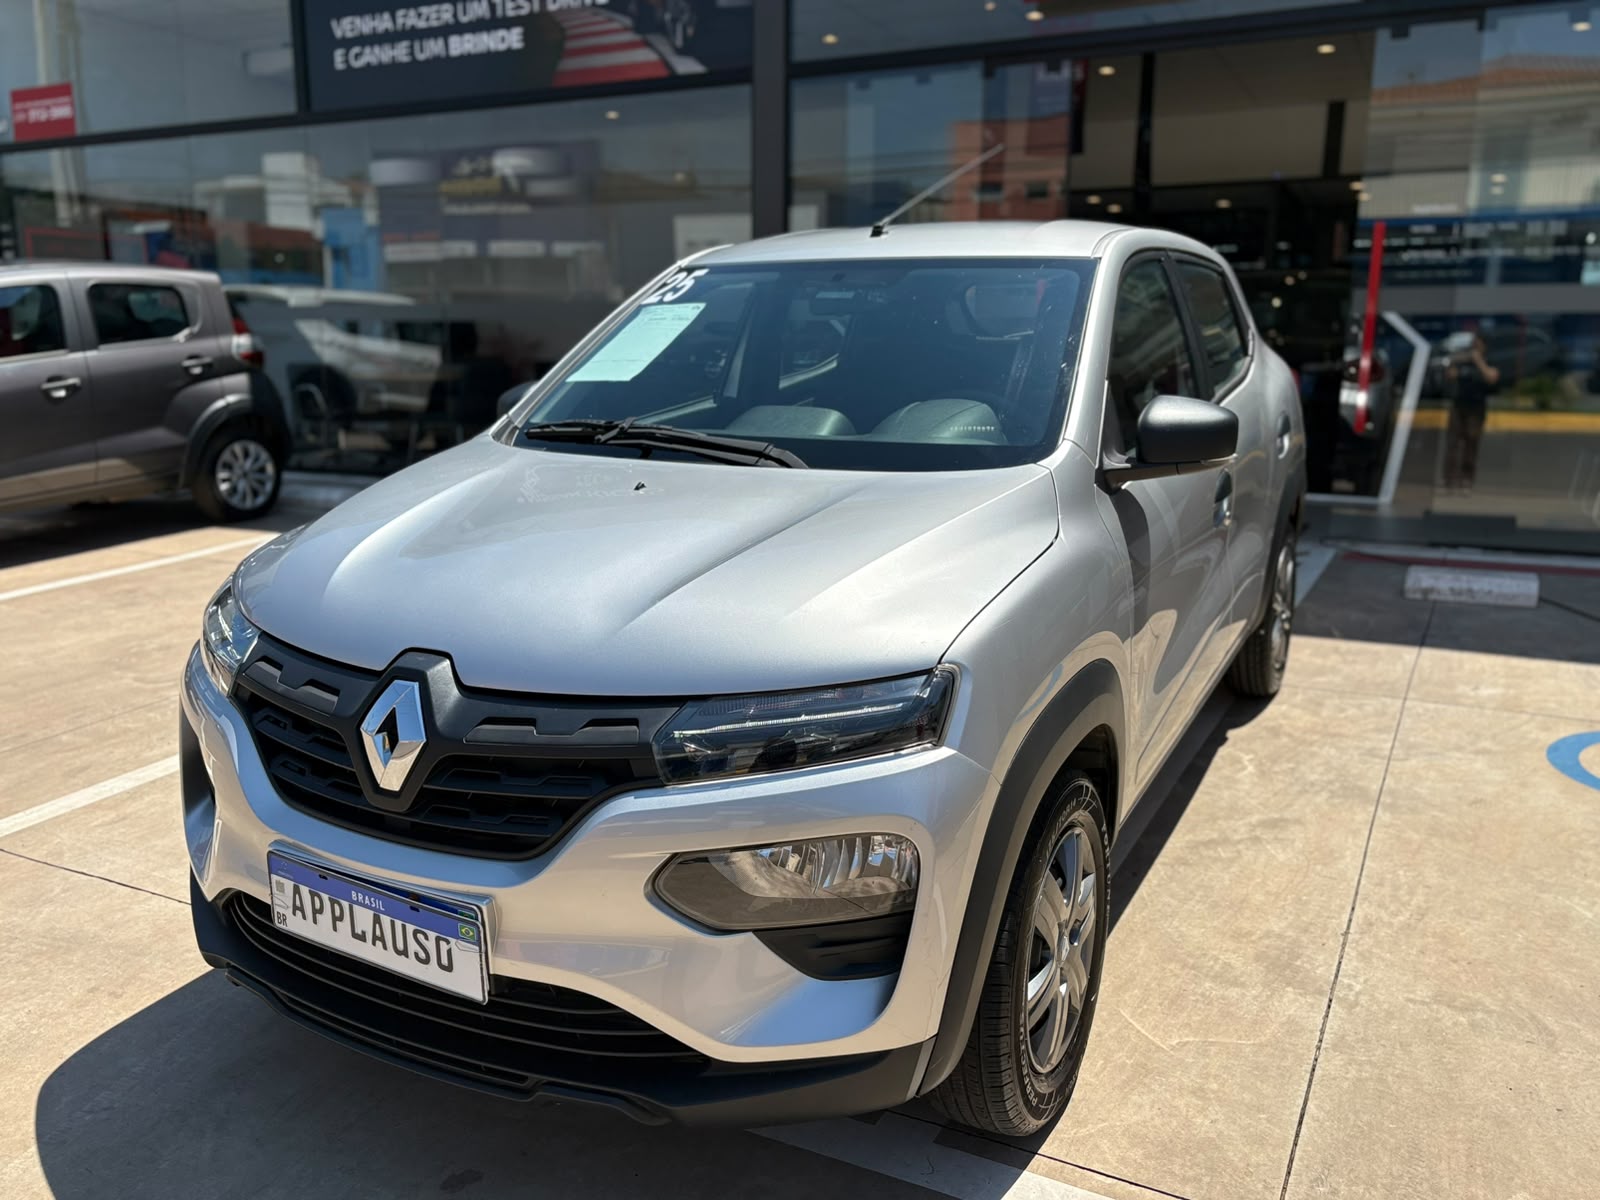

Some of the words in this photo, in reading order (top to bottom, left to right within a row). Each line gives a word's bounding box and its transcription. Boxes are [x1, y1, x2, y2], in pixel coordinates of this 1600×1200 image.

[331, 12, 394, 40] VENHA
[395, 3, 455, 32] FAZER
[456, 0, 492, 23] UM
[493, 0, 541, 20] TEST
[333, 47, 348, 71] E
[349, 40, 413, 69] GANHE
[413, 37, 447, 61] UM
[447, 26, 525, 58] BRINDE
[640, 268, 711, 305] 25
[276, 911, 288, 928] BR
[351, 890, 385, 911] BRASIL
[291, 883, 454, 973] APPLAUSO
